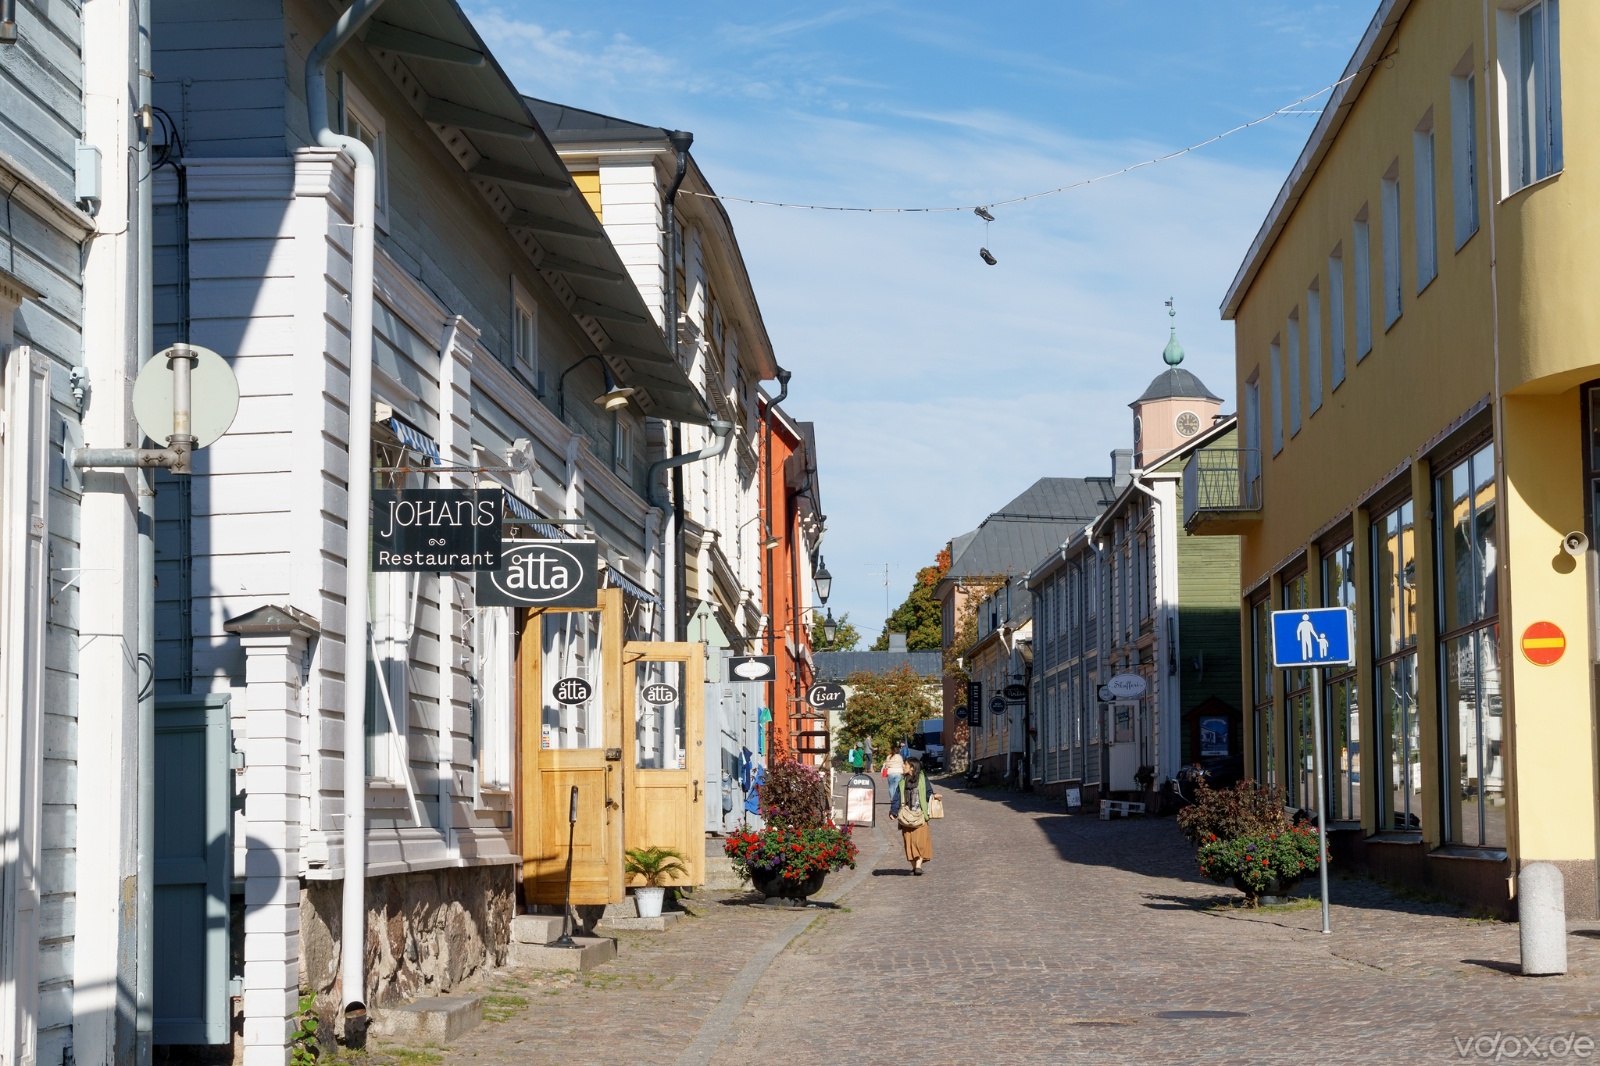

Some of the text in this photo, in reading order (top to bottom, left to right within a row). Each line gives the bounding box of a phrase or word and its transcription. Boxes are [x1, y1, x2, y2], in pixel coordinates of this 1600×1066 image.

[380, 500, 495, 537] JOHANS
[379, 551, 494, 566] Restaurant
[506, 552, 568, 590] åtta
[558, 681, 587, 700] åtta
[648, 686, 674, 702] åtta
[809, 686, 841, 706] Cisar
